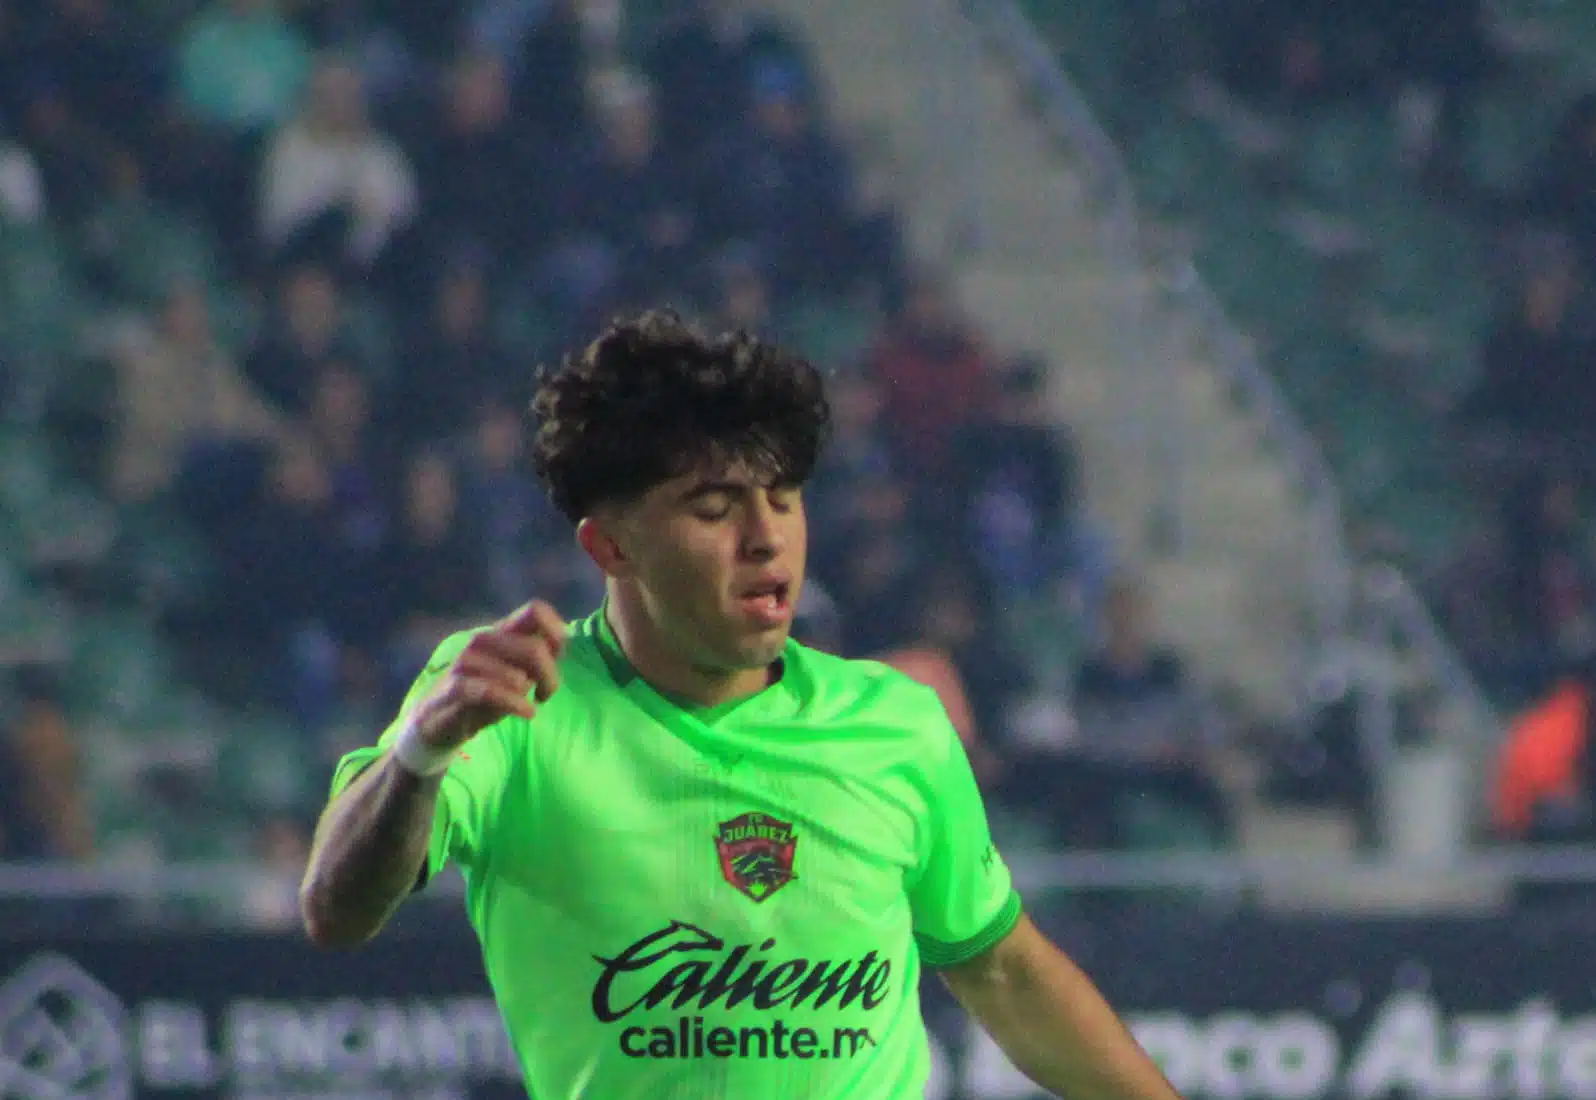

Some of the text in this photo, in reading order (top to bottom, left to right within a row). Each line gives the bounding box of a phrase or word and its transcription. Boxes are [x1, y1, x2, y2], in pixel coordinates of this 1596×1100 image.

[590, 919, 892, 1024] Caliente
[226, 997, 521, 1081] ENCANT
[619, 1016, 876, 1059] caliente.m
